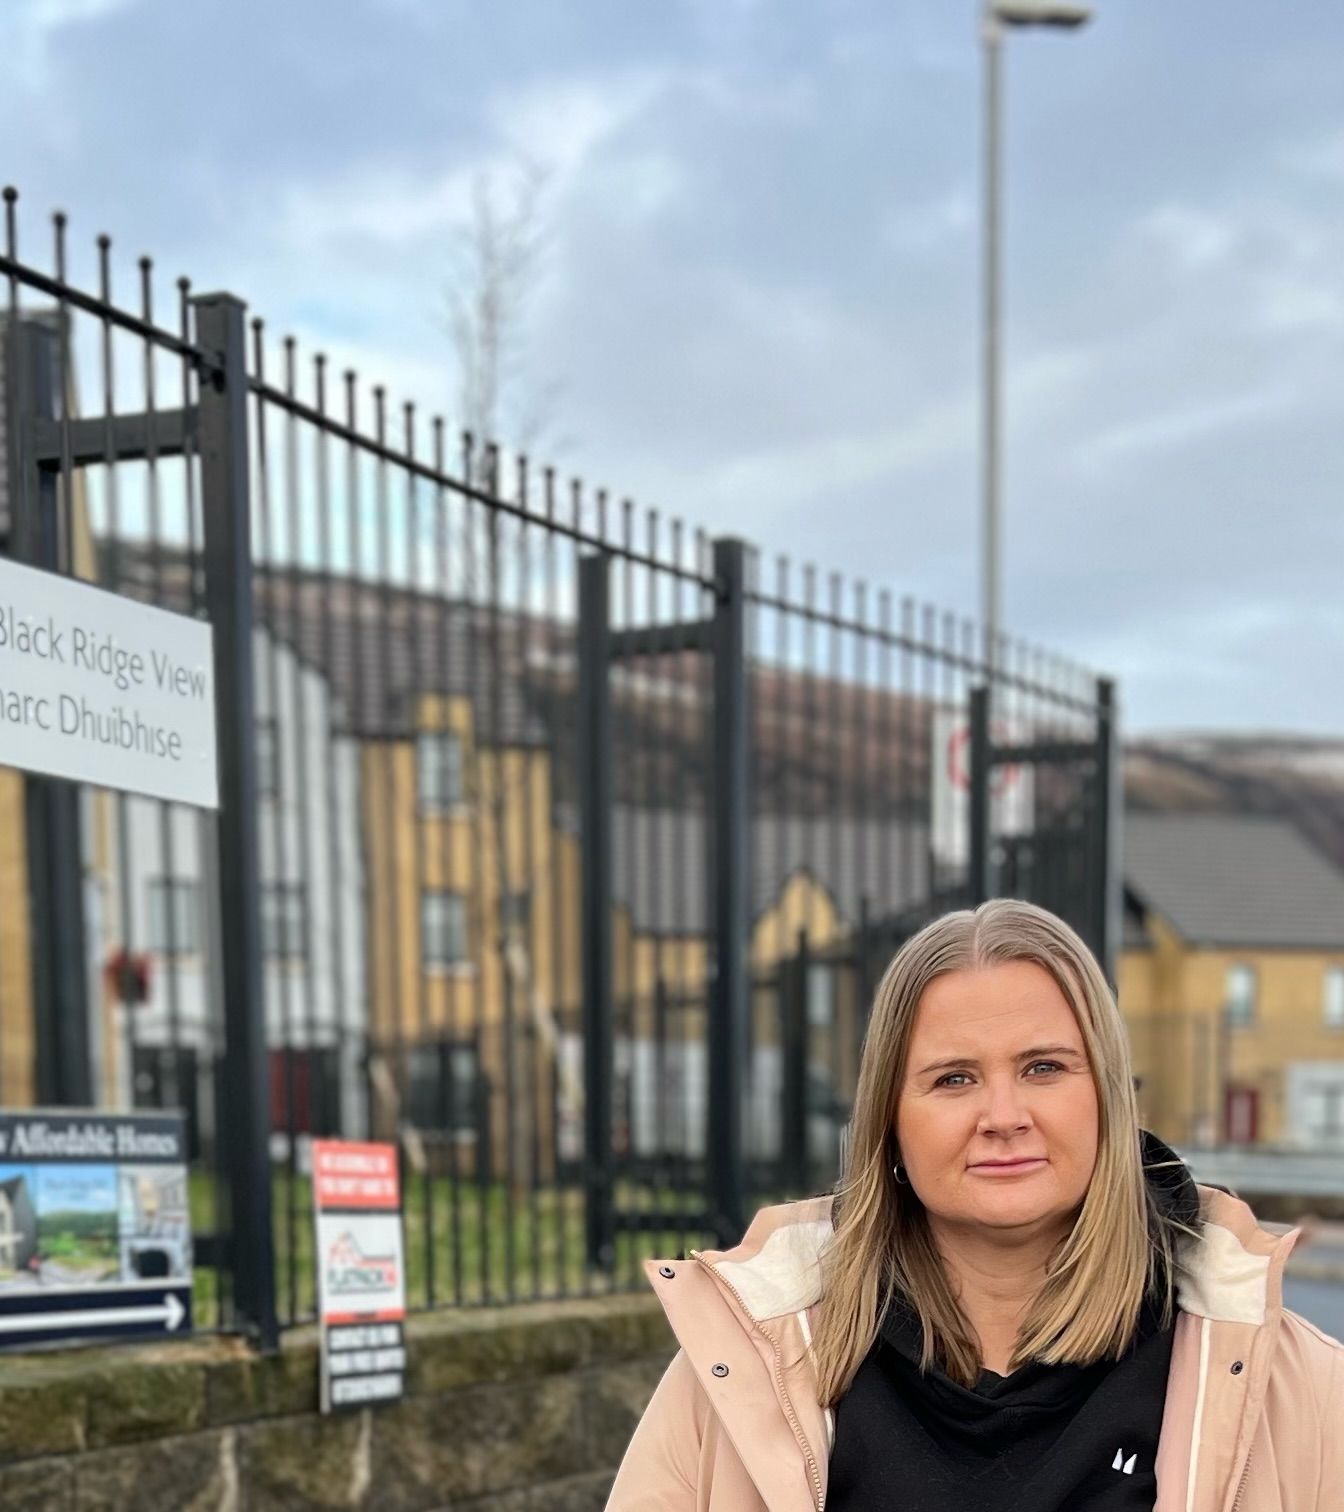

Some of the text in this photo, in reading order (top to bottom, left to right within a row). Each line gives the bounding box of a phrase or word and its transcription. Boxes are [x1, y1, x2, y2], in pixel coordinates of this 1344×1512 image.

[73, 626, 145, 691] Ridge
[150, 649, 206, 700] View
[59, 693, 183, 761] Dhuibhise
[10, 1121, 115, 1157] Affordable
[115, 1124, 179, 1157] Homes
